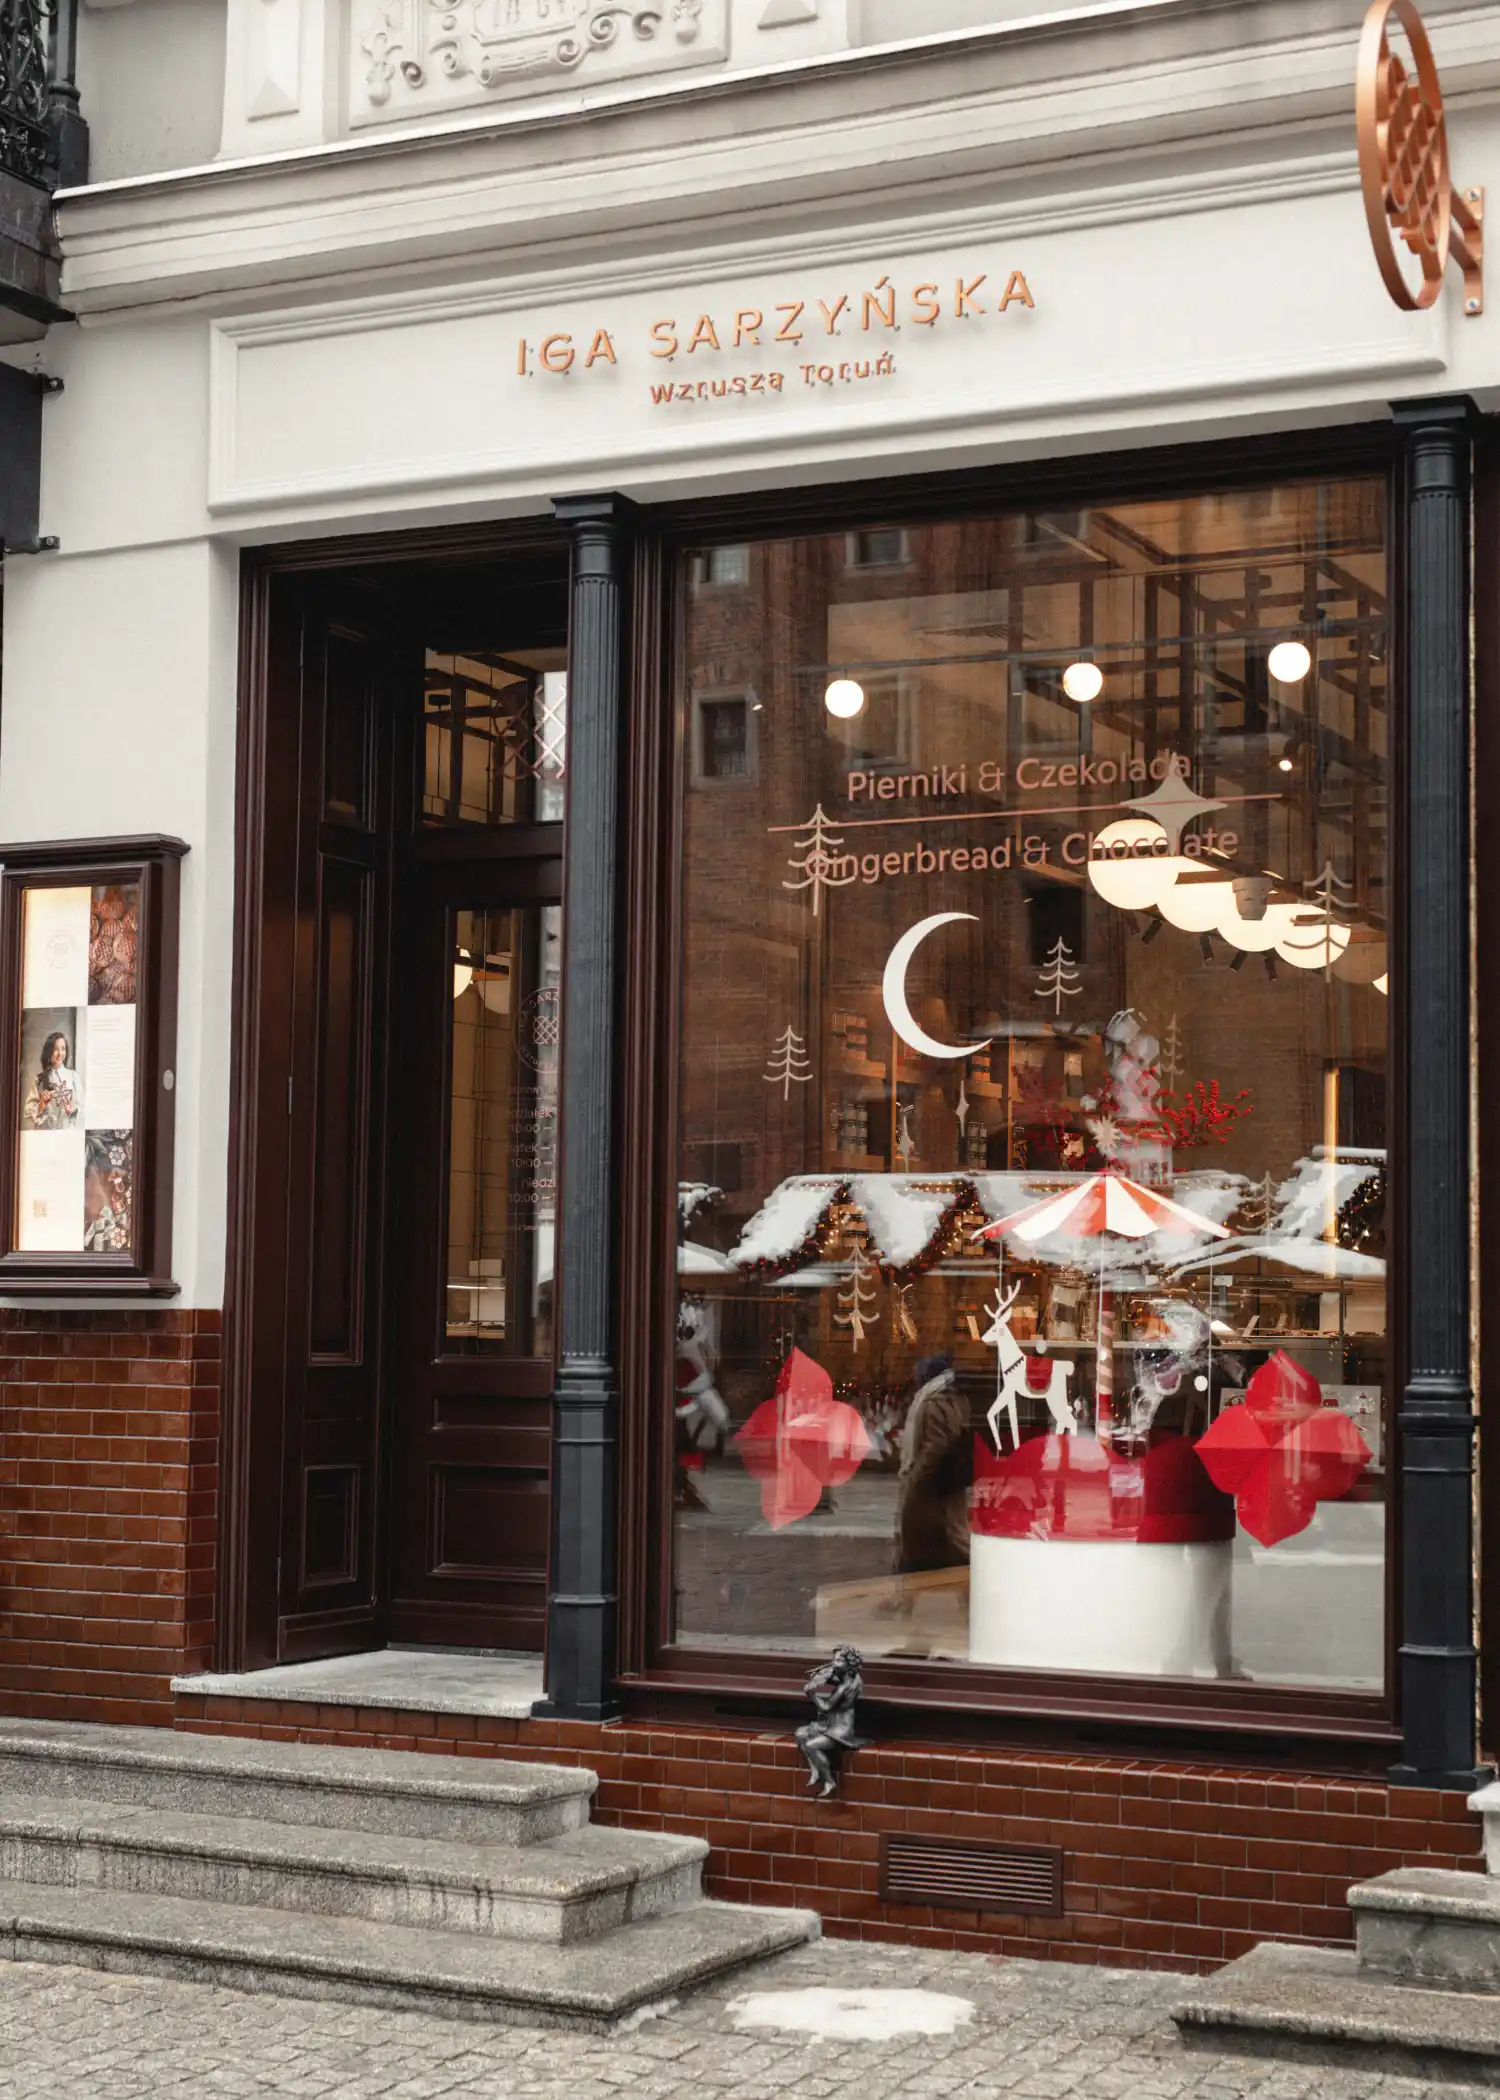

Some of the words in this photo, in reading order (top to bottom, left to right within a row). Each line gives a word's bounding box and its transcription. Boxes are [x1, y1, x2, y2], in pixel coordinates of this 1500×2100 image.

[516, 328, 617, 376] IGA
[648, 270, 1036, 359] SARZYŃSKA
[799, 351, 897, 387] Toruń
[847, 761, 967, 802] Pierniki
[978, 760, 1005, 793] &
[1015, 747, 1192, 791] Czekolada
[804, 835, 1012, 885] Gingerbread
[1022, 834, 1051, 867] &
[1061, 826, 1239, 865] Chocolate
